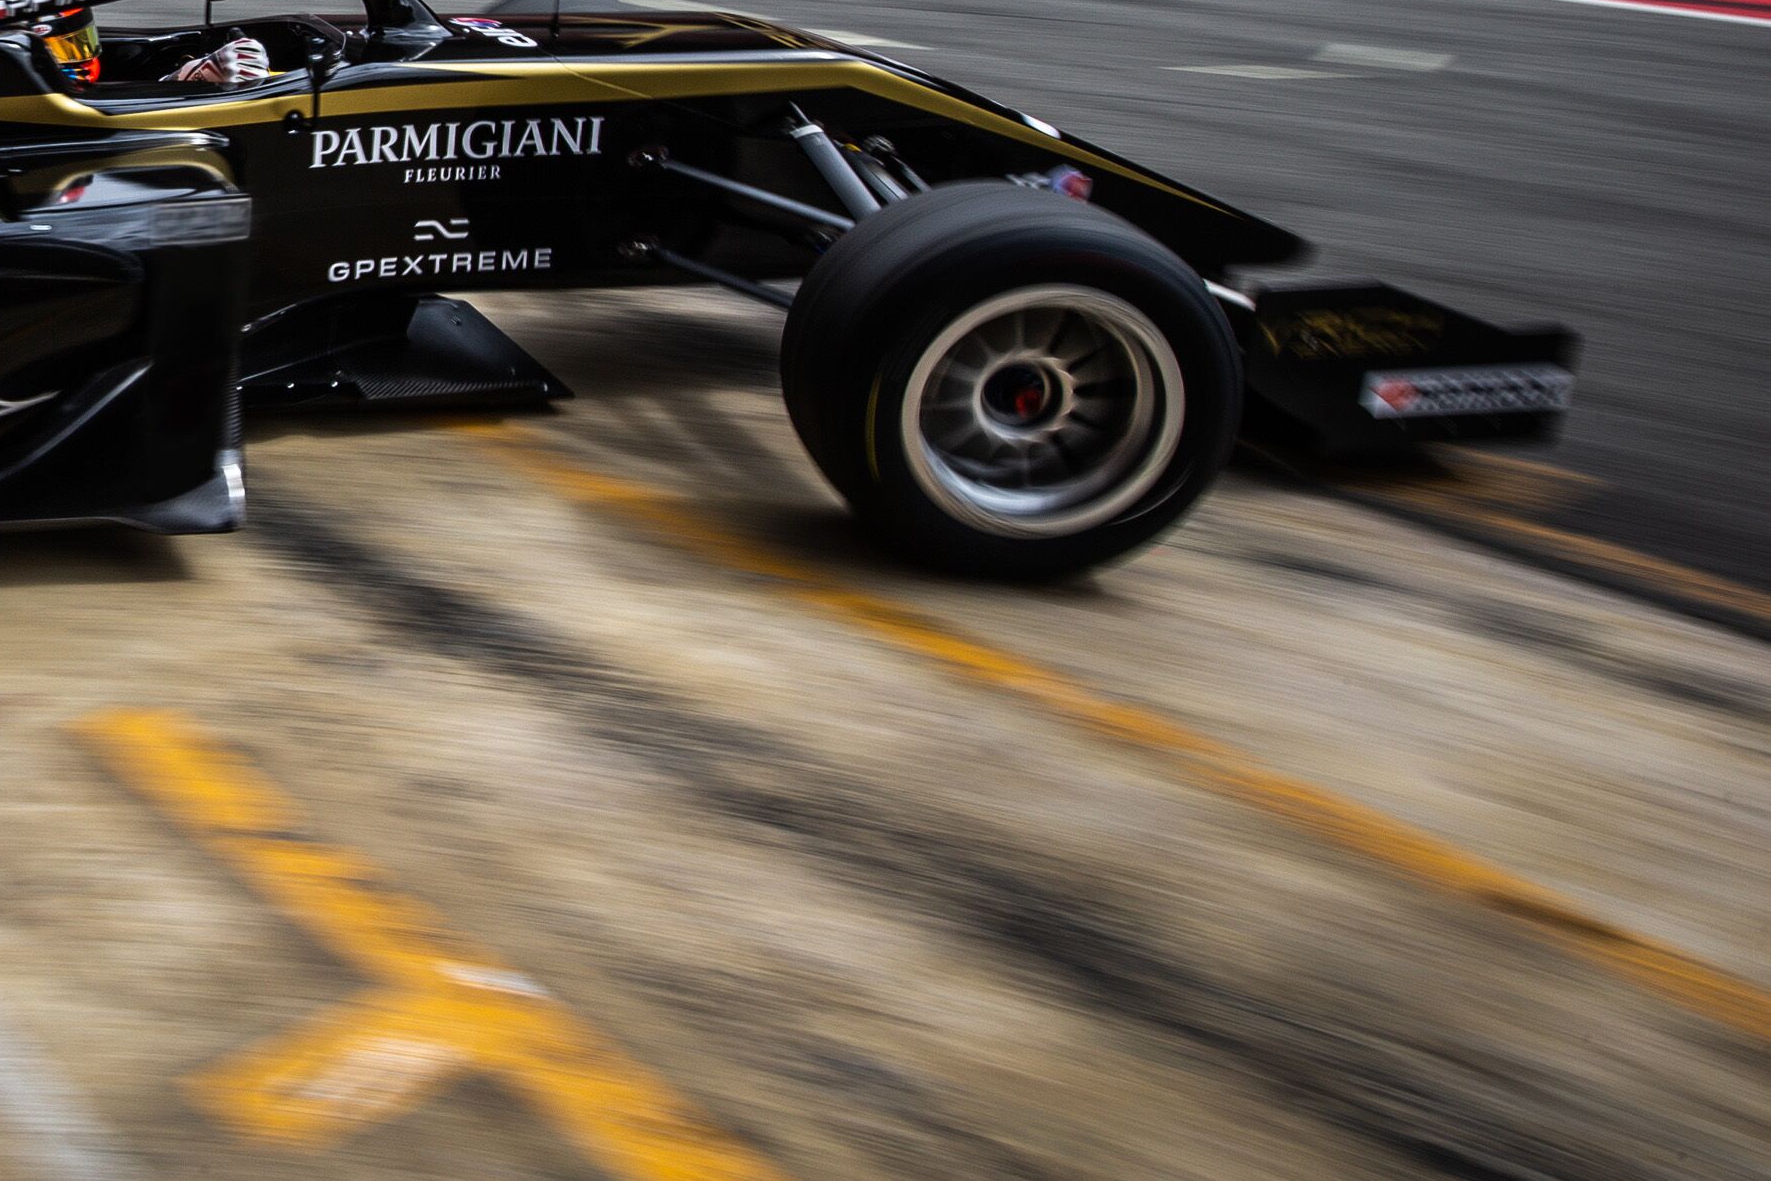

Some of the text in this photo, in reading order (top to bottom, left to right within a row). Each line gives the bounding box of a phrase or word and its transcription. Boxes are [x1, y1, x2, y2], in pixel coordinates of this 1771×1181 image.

[308, 116, 605, 169] PARMIGIANI
[403, 164, 502, 184] FLEURIER
[328, 247, 553, 283] GPEXTREME
